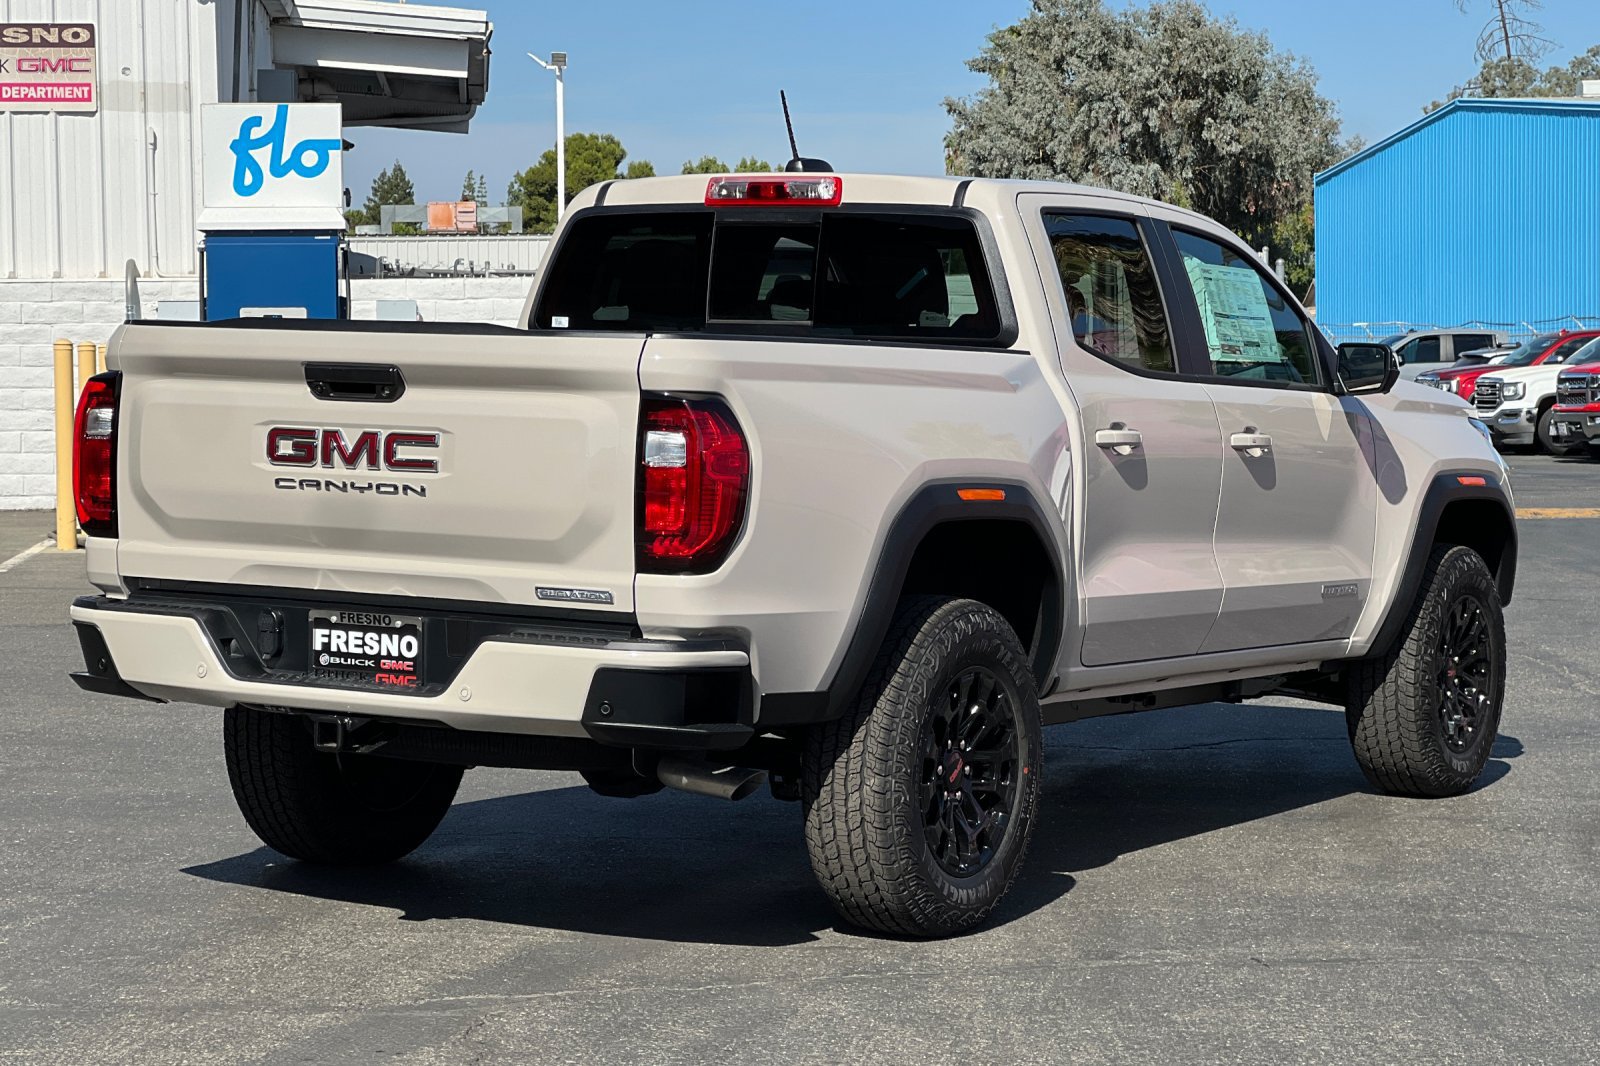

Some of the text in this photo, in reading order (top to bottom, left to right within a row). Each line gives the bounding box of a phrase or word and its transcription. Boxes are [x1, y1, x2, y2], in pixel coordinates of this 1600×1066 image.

[16, 57, 92, 73] GMC
[1, 86, 90, 99] DEPARTMENT
[229, 103, 342, 197] flo
[266, 426, 441, 473] GMC
[274, 477, 427, 497] CANYON
[339, 611, 392, 626] FRESNO
[312, 628, 418, 658] FRESNO
[329, 656, 414, 671] BUICK GMC
[375, 673, 417, 688] GMC
